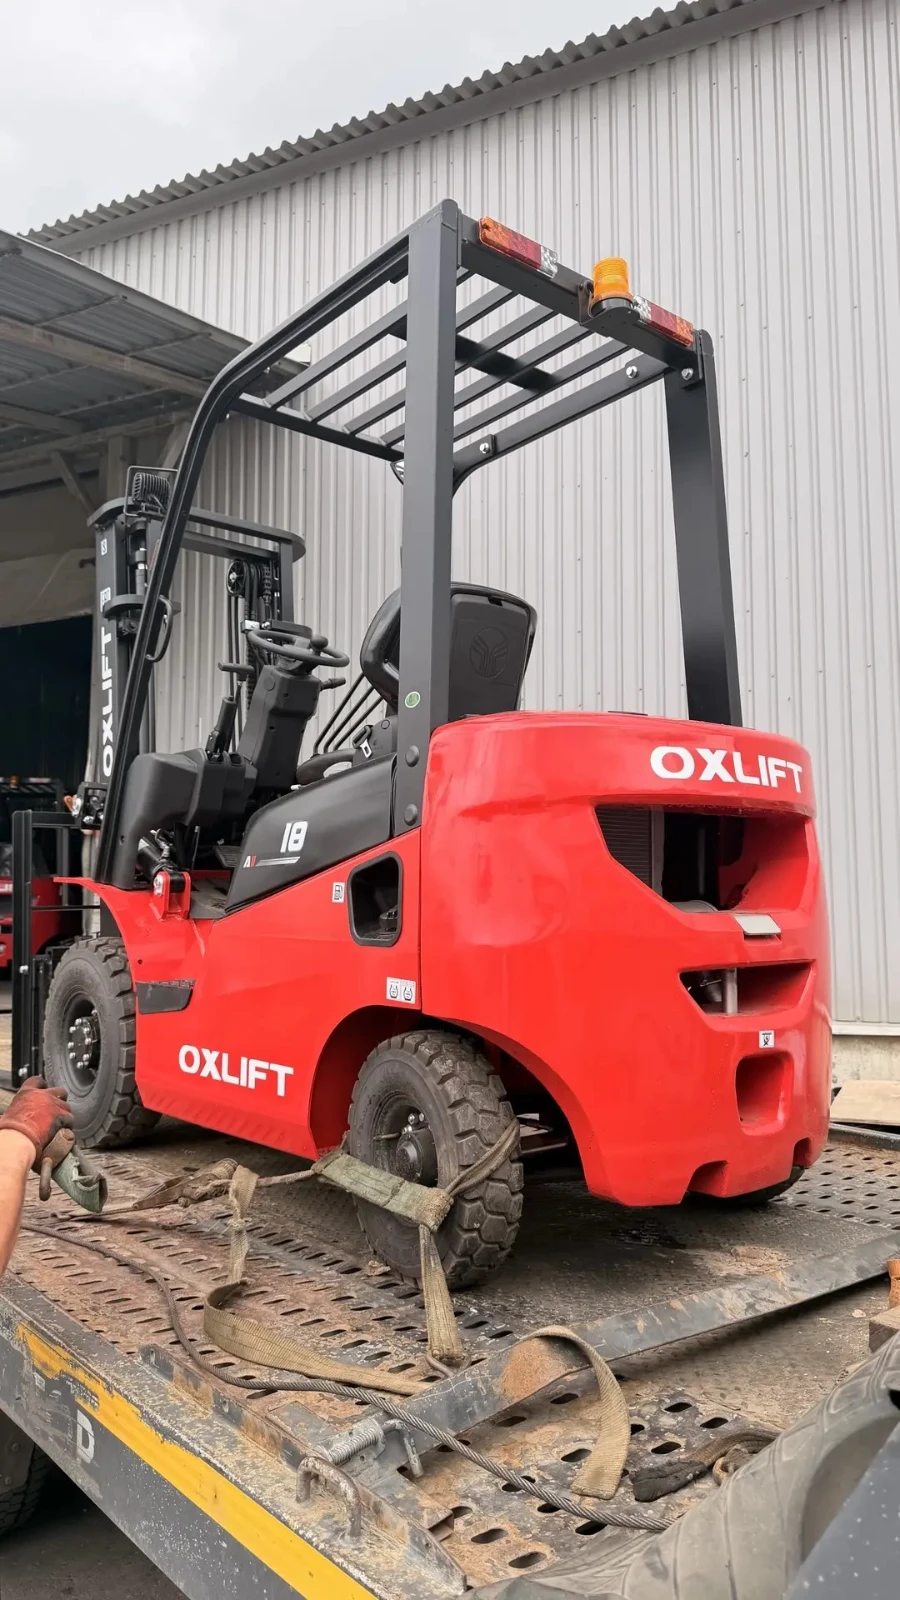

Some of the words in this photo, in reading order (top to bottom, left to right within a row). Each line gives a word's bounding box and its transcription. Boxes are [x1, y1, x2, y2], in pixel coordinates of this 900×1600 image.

[101, 626, 114, 777] OXLIFT
[650, 745, 803, 793] OXLIFT
[280, 821, 309, 853] 18
[178, 1044, 294, 1097] OXLIFT
